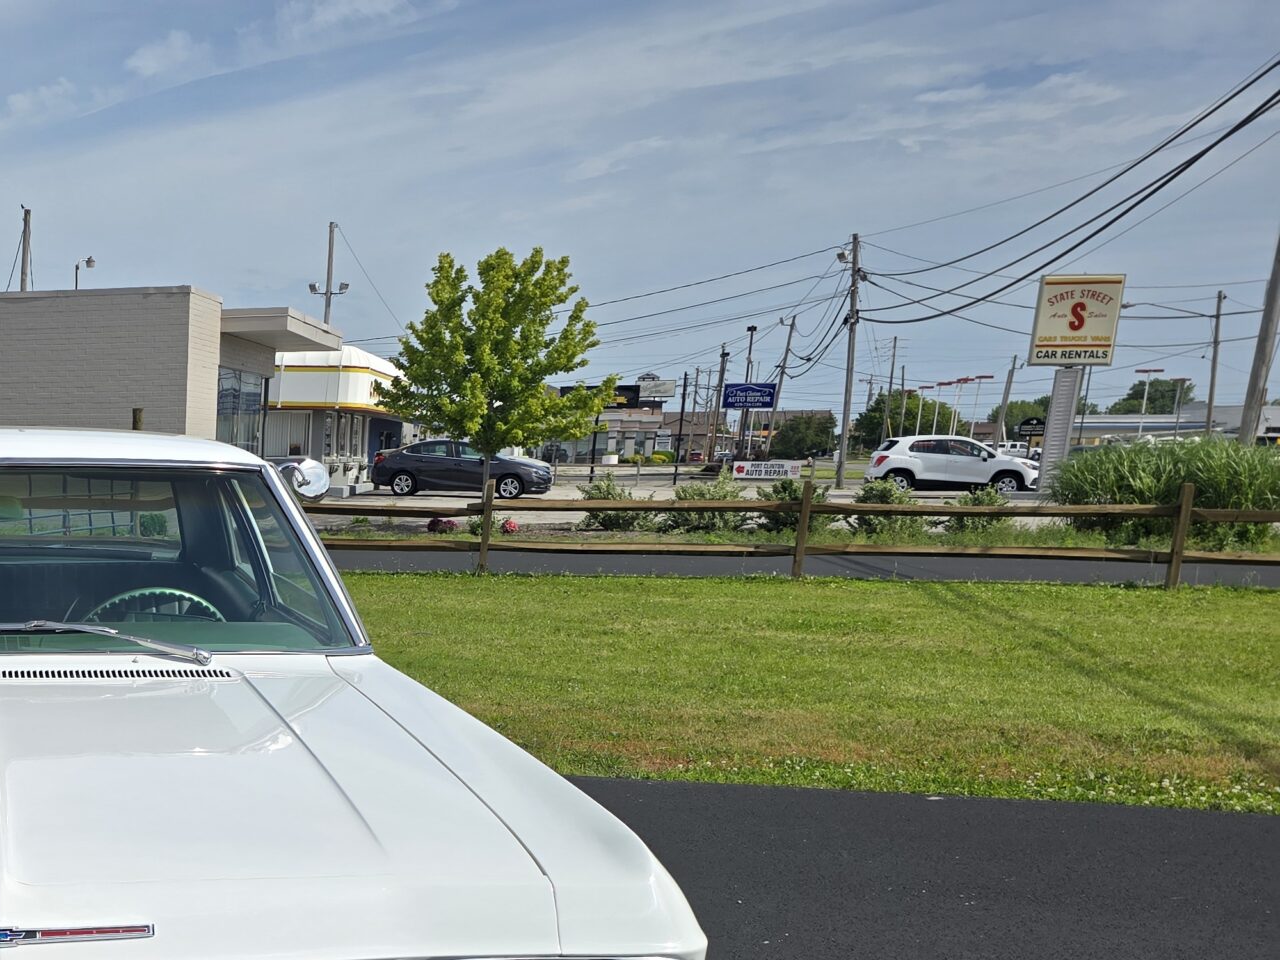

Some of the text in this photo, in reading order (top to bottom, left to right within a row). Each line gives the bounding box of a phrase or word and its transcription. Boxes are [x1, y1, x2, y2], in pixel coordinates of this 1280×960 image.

[1047, 289, 1114, 307] STATE STREET
[1069, 301, 1087, 331] S
[1035, 350, 1109, 359] CAR RENTALS
[745, 469, 763, 477] AUTO
[763, 469, 789, 477] REPAIR
